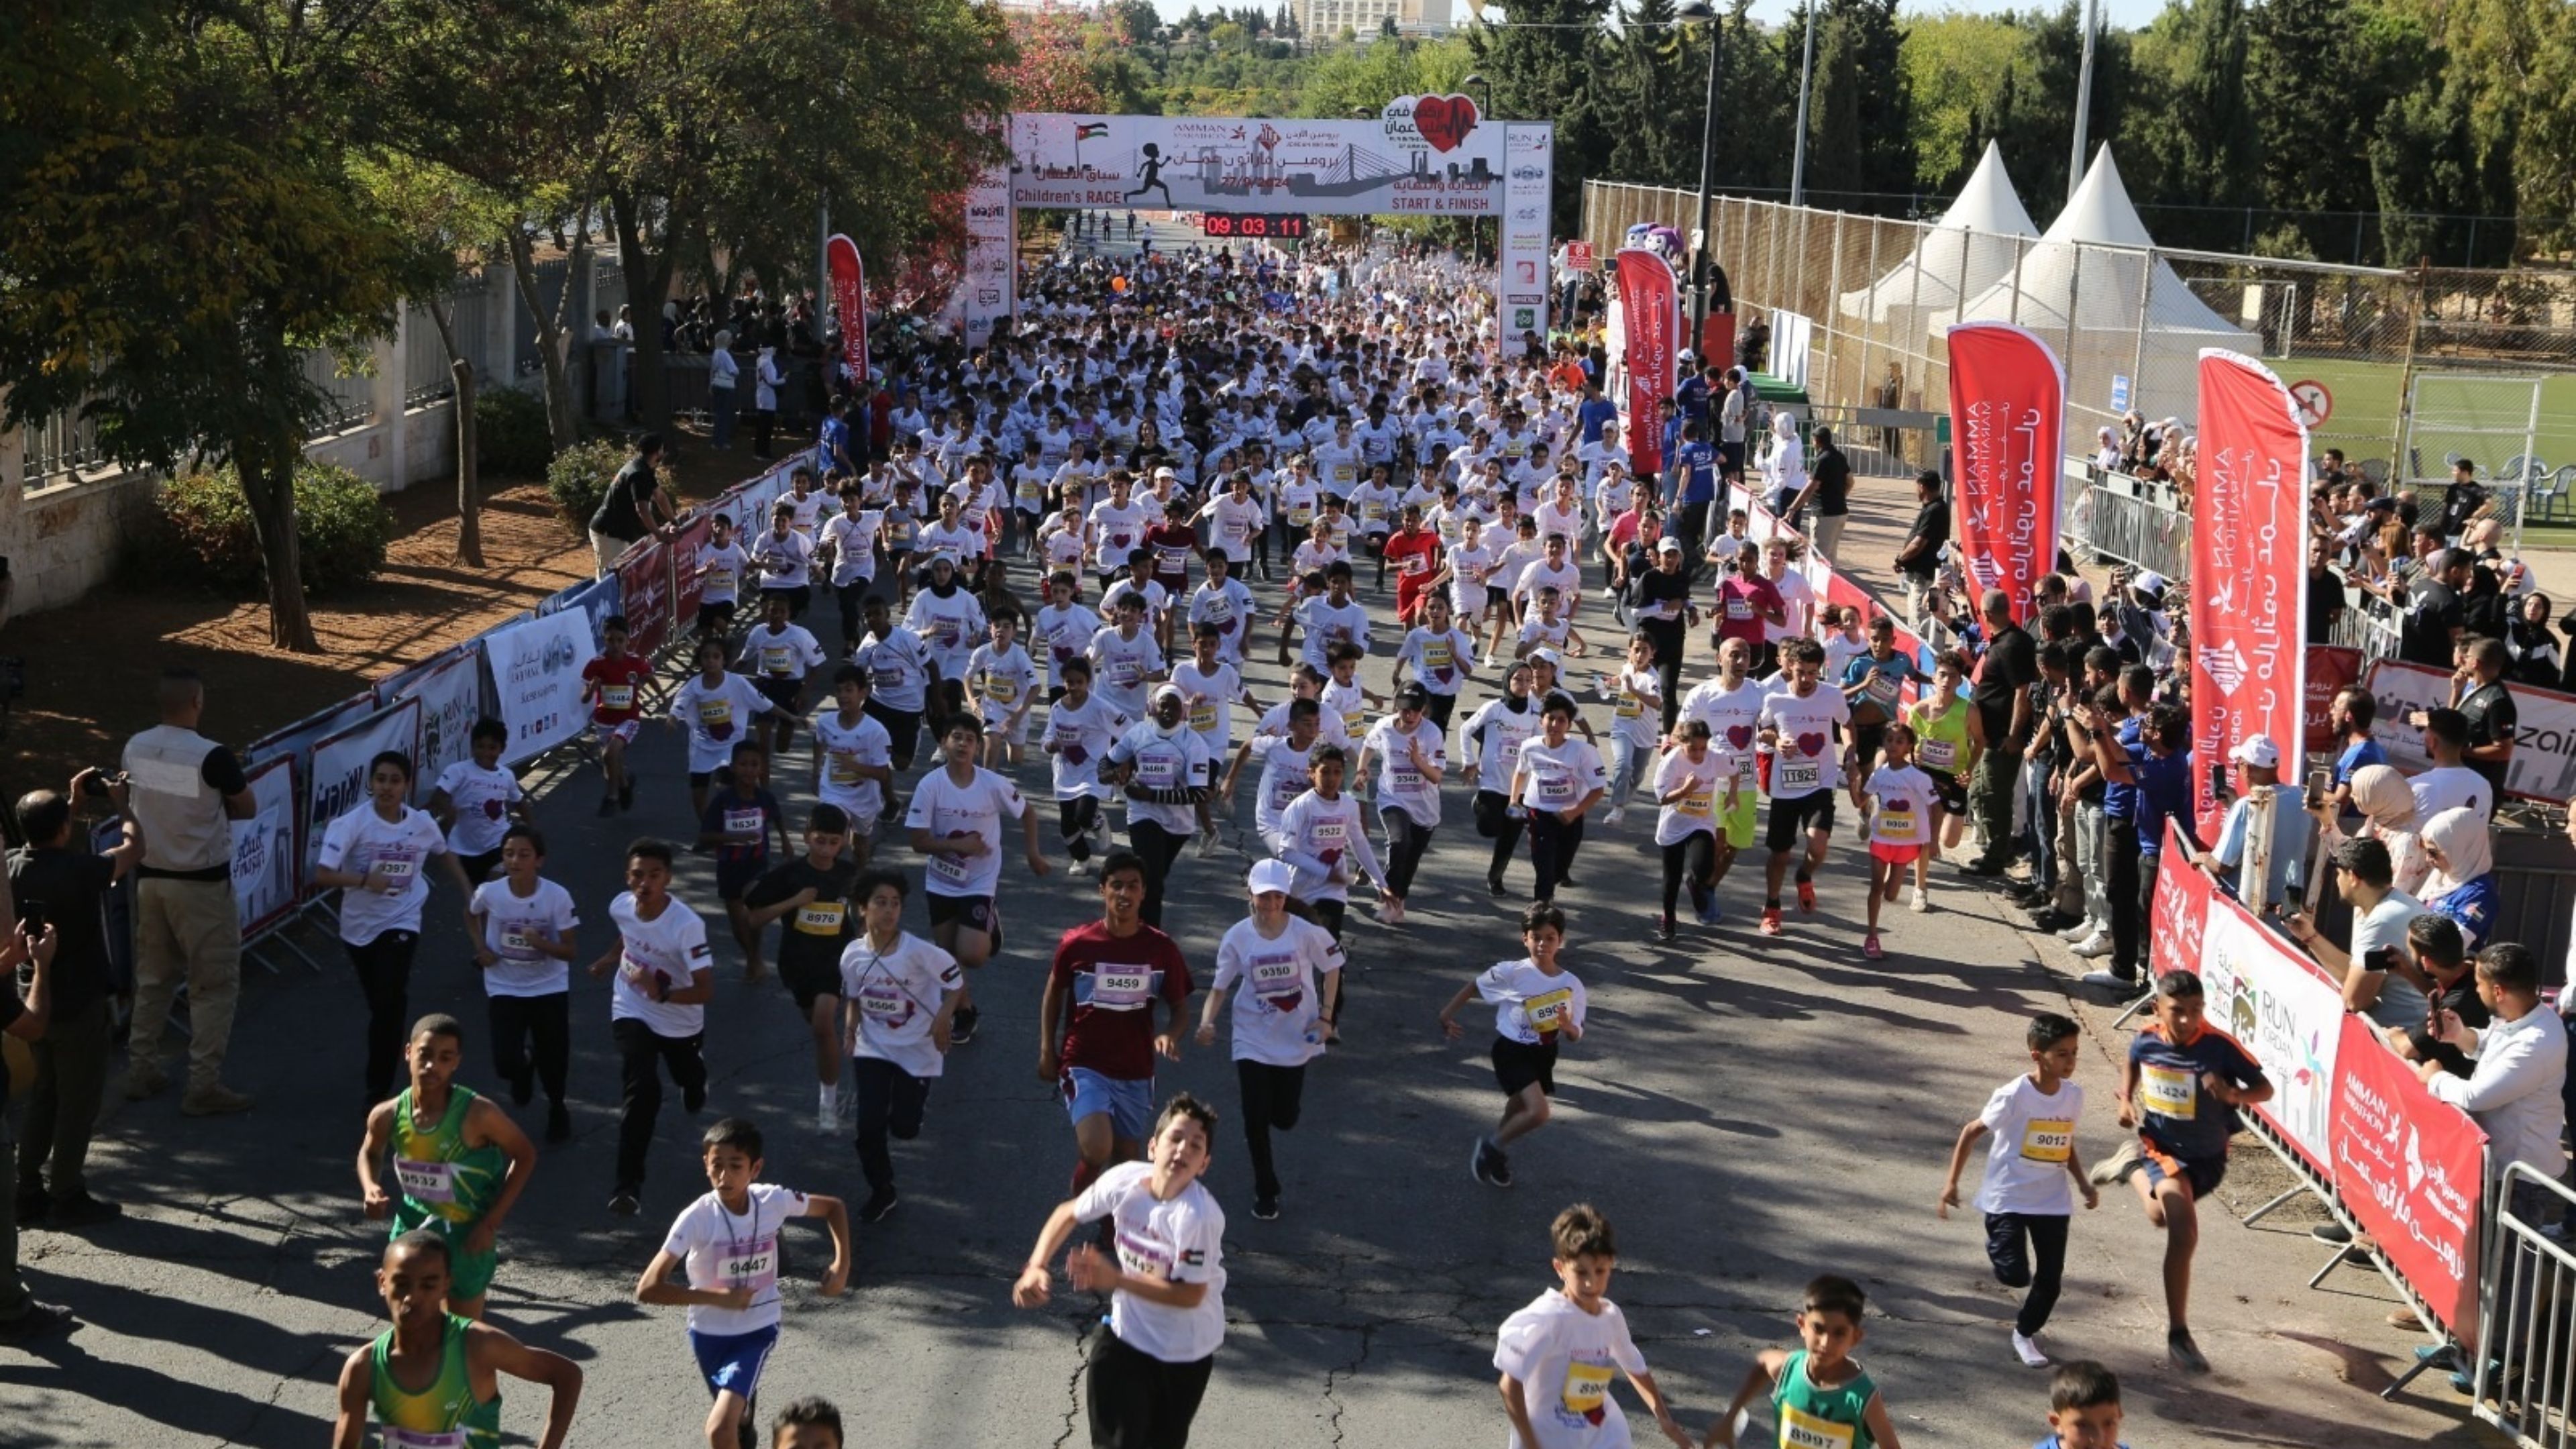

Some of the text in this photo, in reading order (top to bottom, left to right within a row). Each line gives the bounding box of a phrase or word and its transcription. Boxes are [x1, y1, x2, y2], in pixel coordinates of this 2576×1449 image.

[1174, 123, 1227, 132] AMMAN
[1509, 134, 1532, 142] RUN
[1015, 190, 1122, 204] Children's RACE
[1392, 197, 1489, 210] START & FINISH
[1107, 978, 1139, 989] 9459
[2263, 989, 2297, 1040] RUN
[2345, 1071, 2388, 1118] AMMAN
[730, 1256, 769, 1275] 9447
